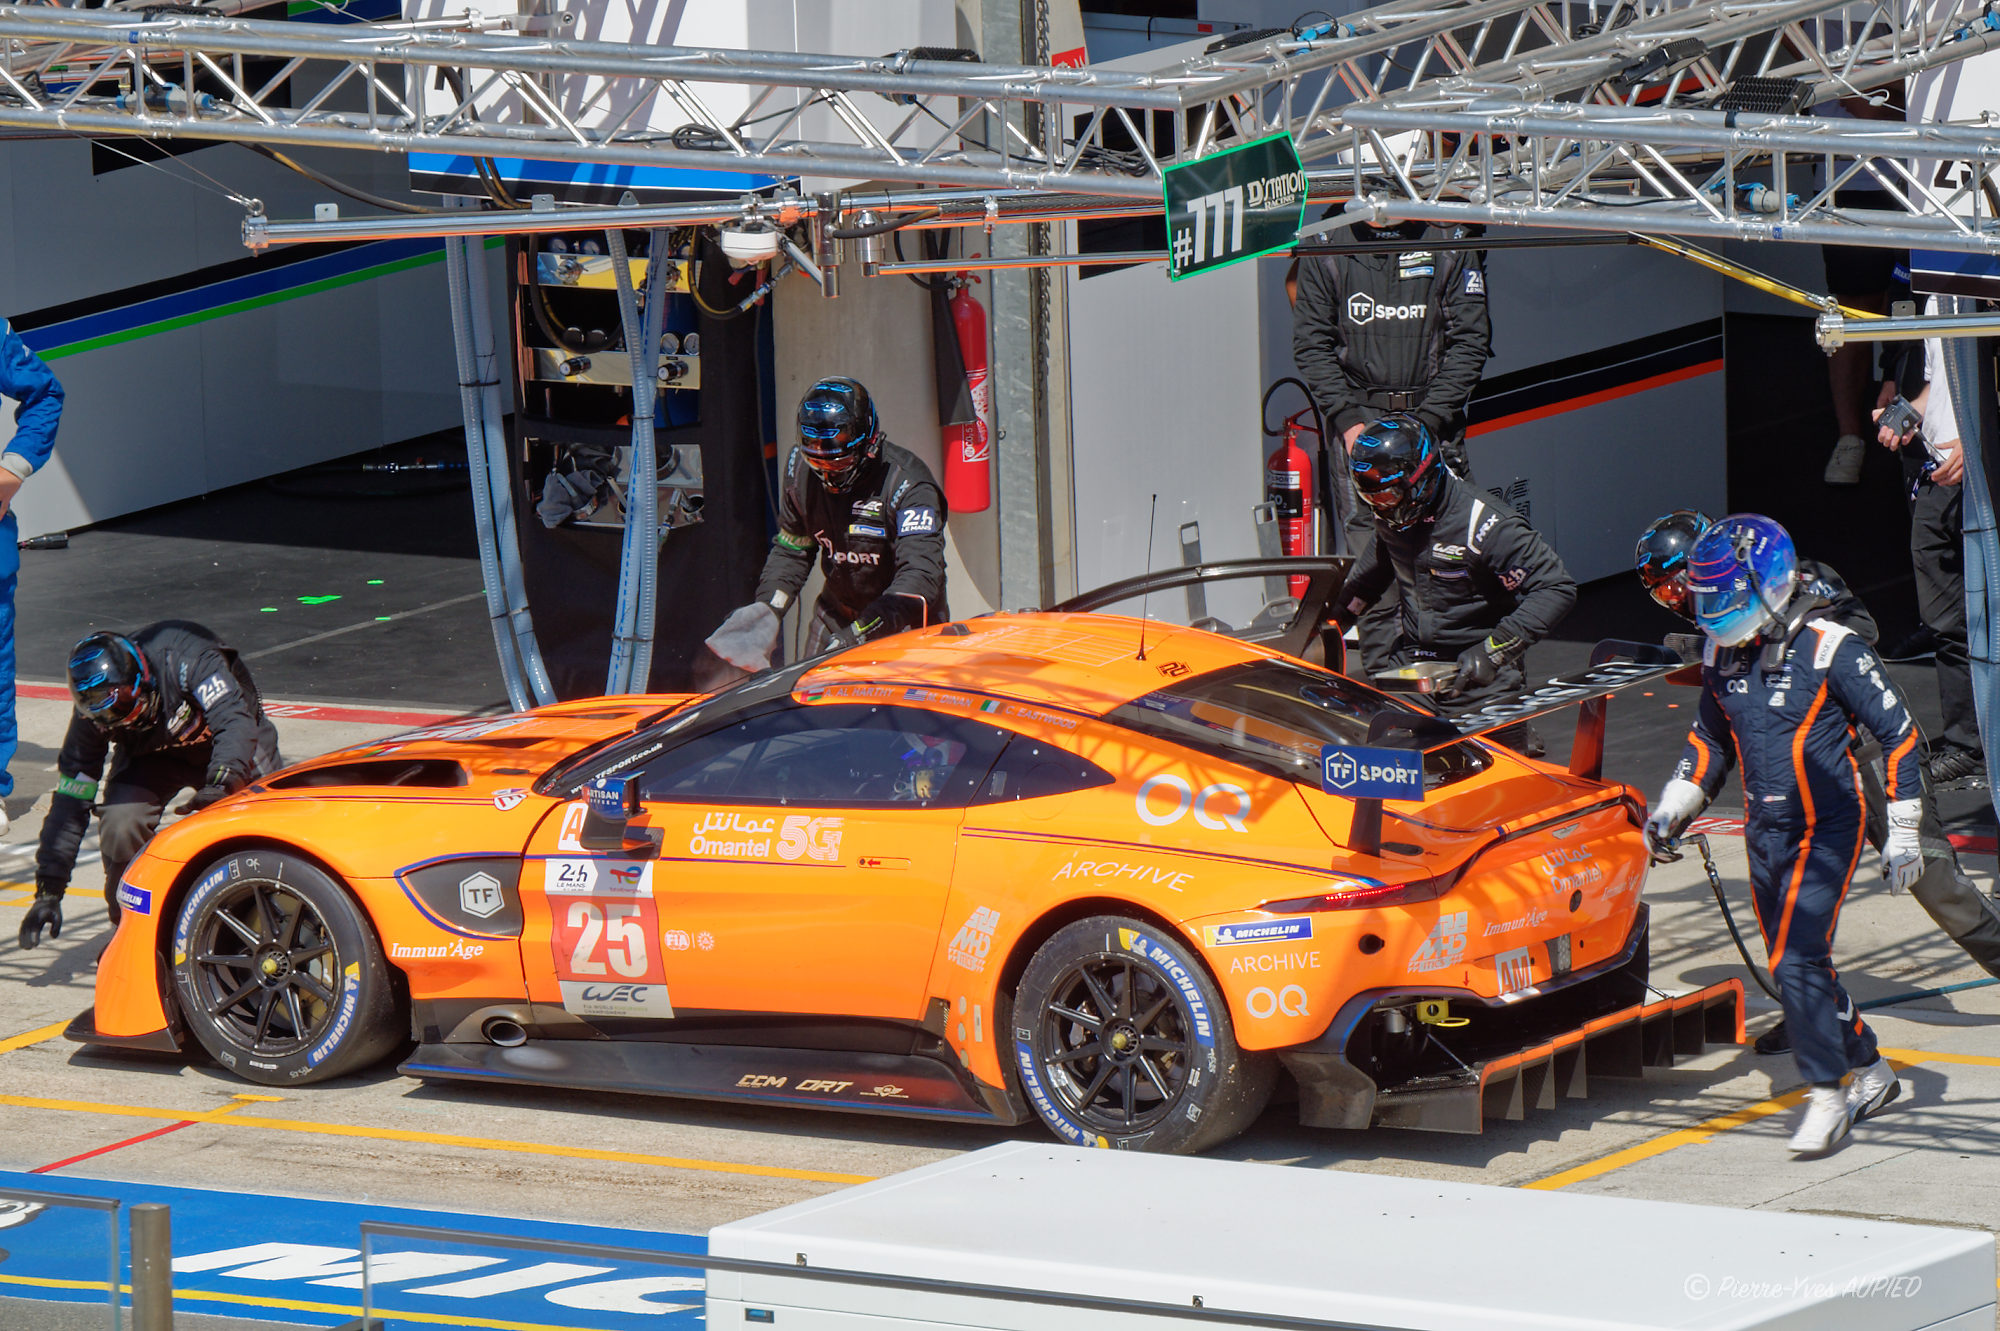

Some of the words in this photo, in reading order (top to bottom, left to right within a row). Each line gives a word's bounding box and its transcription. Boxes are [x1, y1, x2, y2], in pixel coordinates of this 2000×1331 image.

[1247, 170, 1305, 207] D'STATION
[1264, 194, 1295, 210] RACING
[1351, 302, 1371, 316] TF
[1375, 304, 1427, 320] SPORT
[903, 509, 934, 526] 24h
[910, 523, 932, 531] MANS
[1433, 542, 1466, 556] WEC
[197, 676, 227, 703] 24h
[1727, 679, 1748, 693] OQ
[1017, 706, 1076, 729] EASTWOOD
[1330, 762, 1350, 779] TF
[1360, 765, 1418, 785] SPORT
[587, 789, 619, 800] ARTISAN
[1135, 774, 1252, 833] OQ
[693, 812, 775, 835] عمانتل
[689, 835, 770, 857] Omantel
[776, 815, 845, 861] 5G
[559, 863, 588, 882] 24h
[1052, 861, 1195, 892] ARCHIVE
[1551, 863, 1603, 894] Omantel
[179, 870, 224, 935] MICHELIN
[468, 888, 493, 904] TF
[567, 902, 648, 978] 25
[1235, 925, 1300, 938] MICHELIN
[391, 938, 484, 960] Immun'Âge
[1230, 951, 1321, 974] ARCHIVE
[1501, 955, 1532, 994] AM
[582, 985, 648, 1003] WEC
[1150, 947, 1211, 1037] MICHELIN
[1246, 984, 1310, 1019] OQ
[312, 996, 355, 1063] MICHELIN
[738, 1074, 788, 1088] CCM
[1019, 1051, 1079, 1140] MICHELIN
